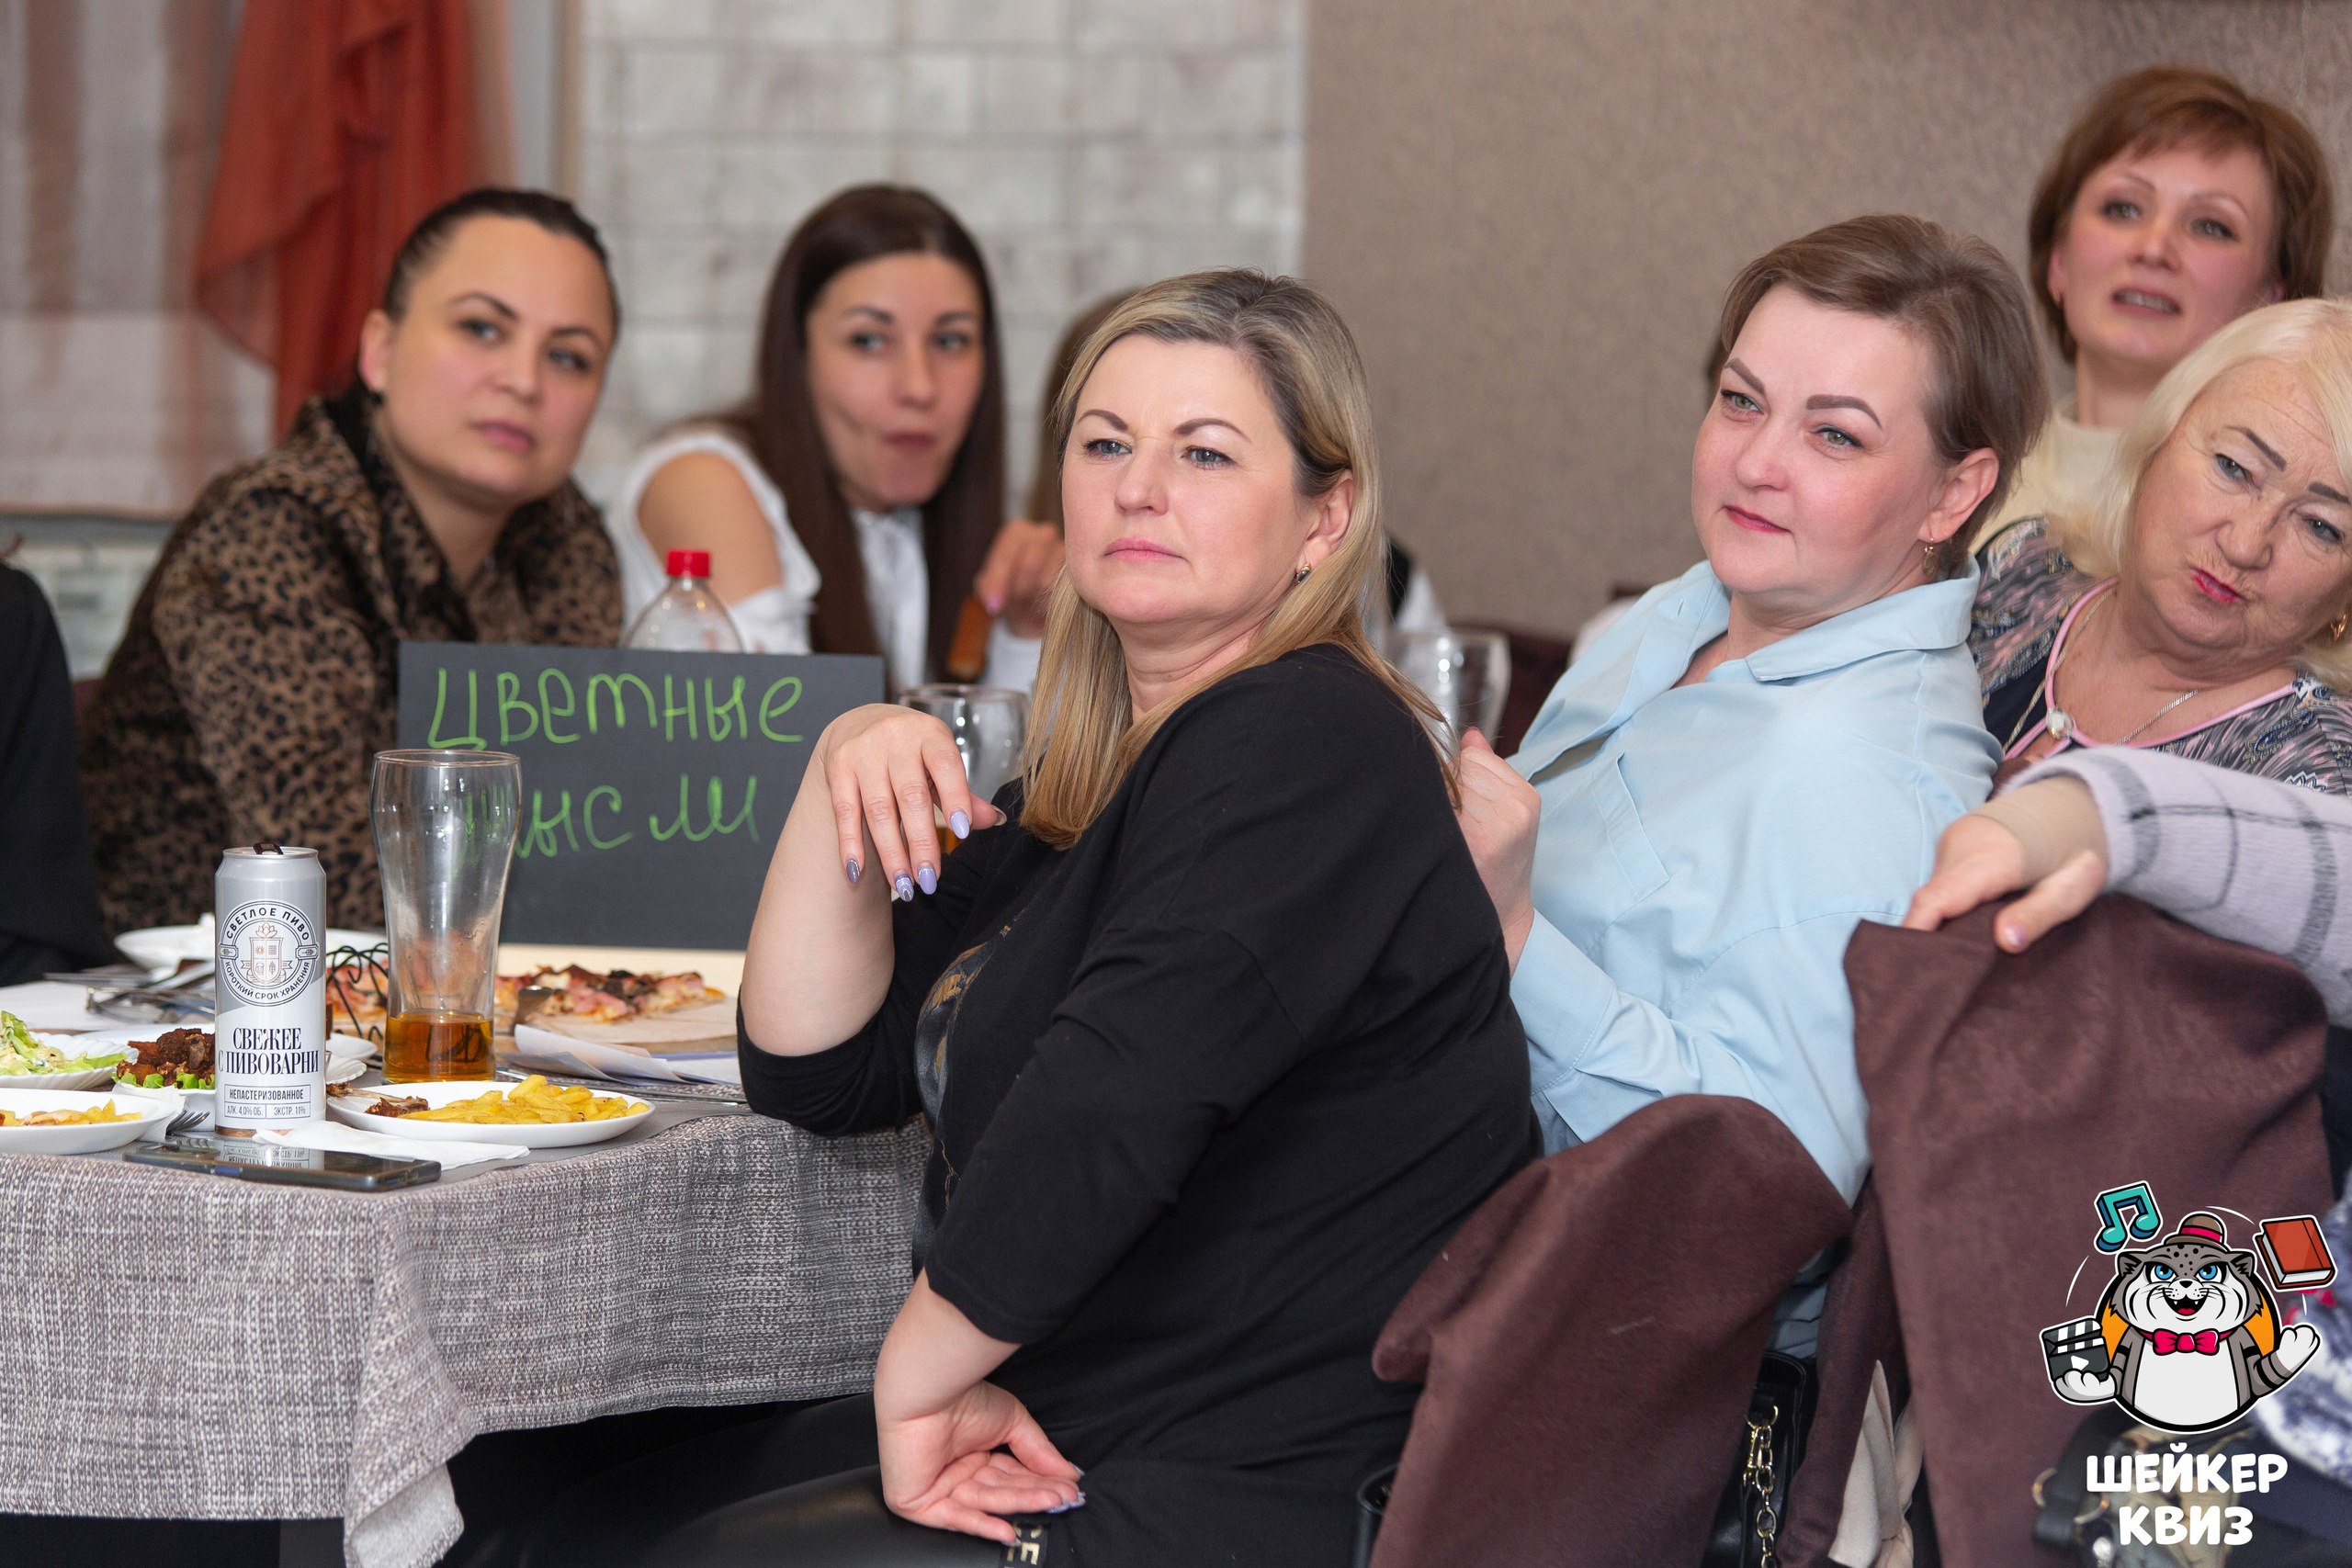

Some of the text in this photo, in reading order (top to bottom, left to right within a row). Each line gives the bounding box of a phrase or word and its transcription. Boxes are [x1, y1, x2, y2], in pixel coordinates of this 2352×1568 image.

[226, 907, 310, 941] СВЕТЛОЕ ПИВО
[224, 961, 311, 1000] КОРОТКИЙ СРОК ХРАНЕНИЯ
[232, 1027, 302, 1051] СВЕЖЕЕ
[218, 1049, 319, 1076] С ПИВОВАРНИ
[229, 1089, 304, 1100] НЕПАСТЕРИЗОВАННОЕ
